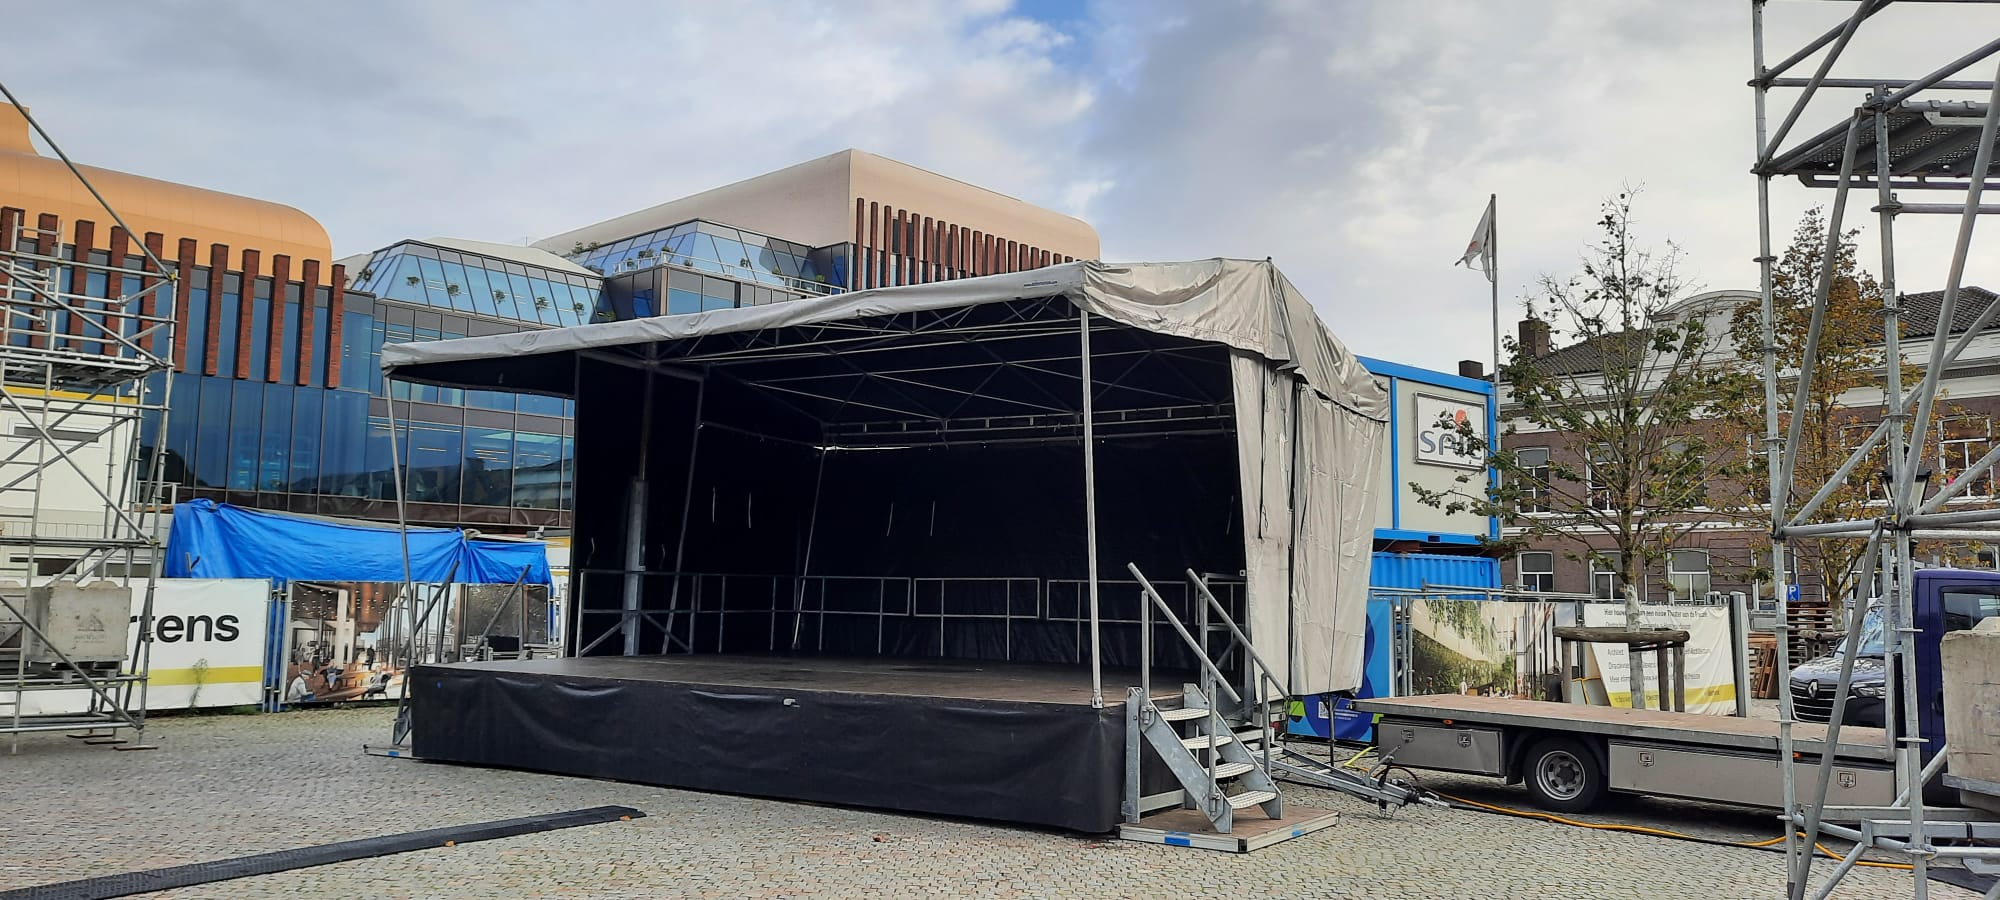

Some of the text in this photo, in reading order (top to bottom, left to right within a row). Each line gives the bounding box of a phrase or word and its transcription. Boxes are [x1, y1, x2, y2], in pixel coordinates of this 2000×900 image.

[1420, 431, 1482, 459] SP
[1789, 586, 1797, 596] P
[130, 614, 240, 643] tens
